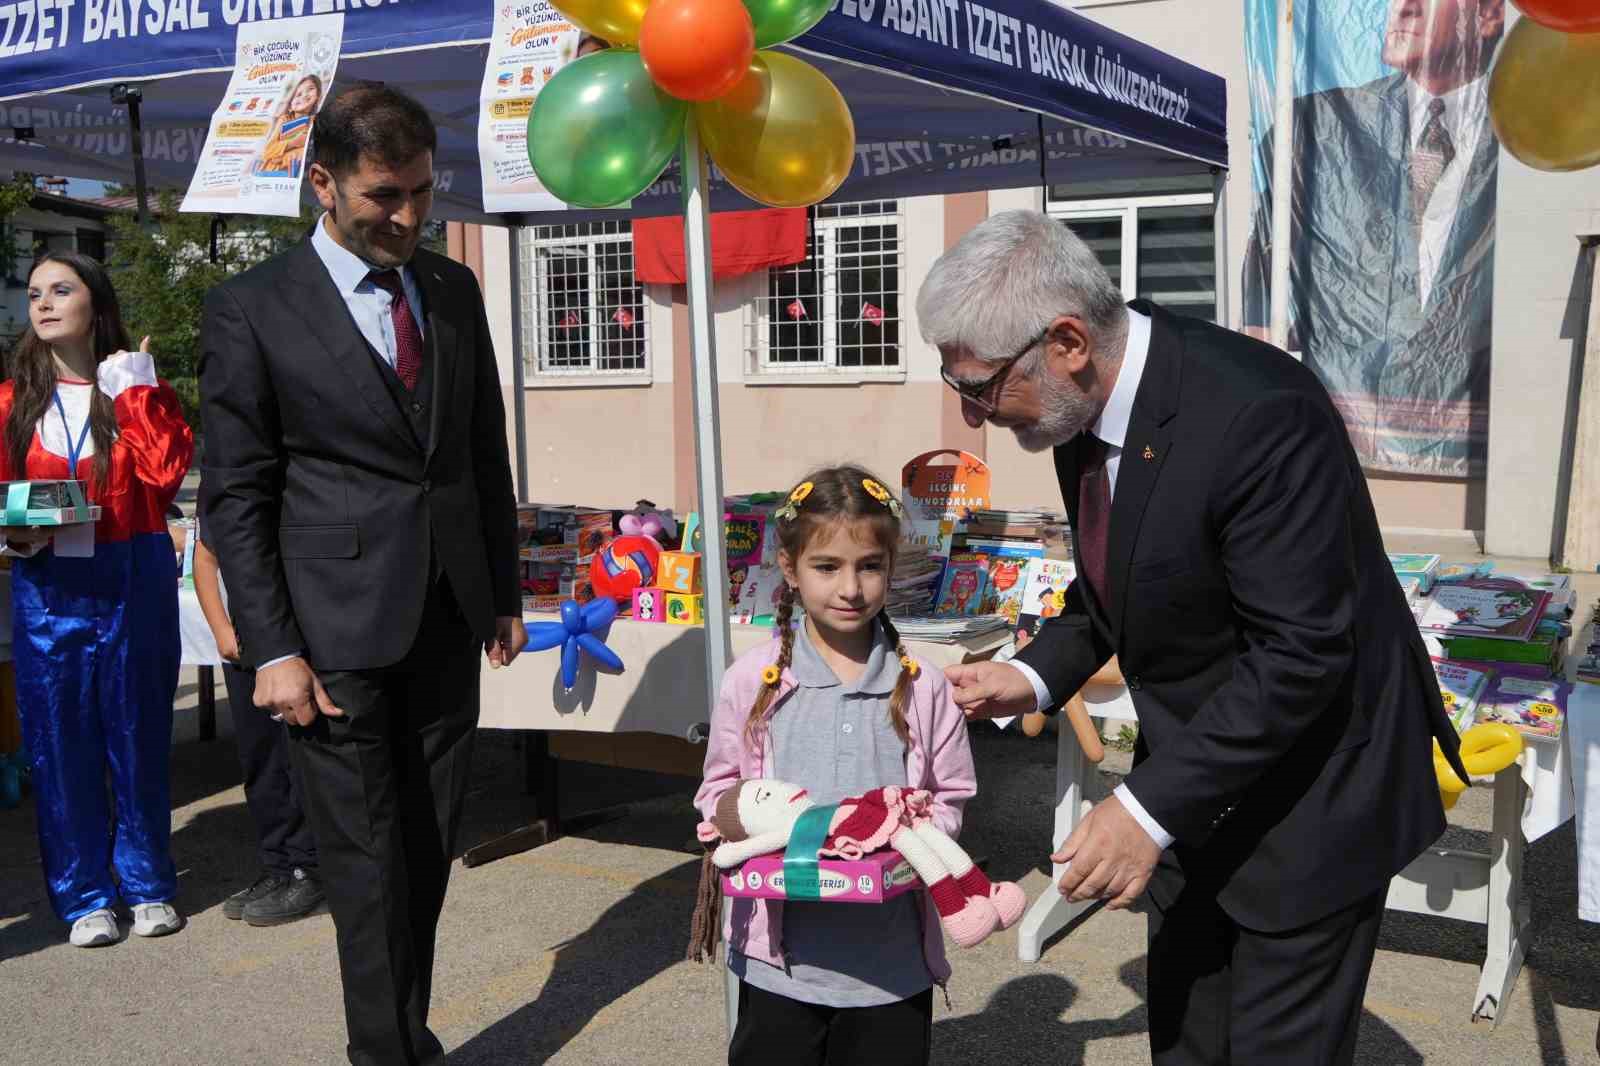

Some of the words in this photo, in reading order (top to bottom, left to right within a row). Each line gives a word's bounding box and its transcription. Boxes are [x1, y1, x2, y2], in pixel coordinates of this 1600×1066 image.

[83, 0, 209, 43] BAYSAL
[525, 37, 549, 49] OLUN
[882, 0, 959, 49] ABANT
[1026, 24, 1099, 95] BAYSAL
[1094, 45, 1192, 125] ÜNİVERSİTESİ
[662, 555, 676, 578] Y
[675, 566, 689, 589] Z
